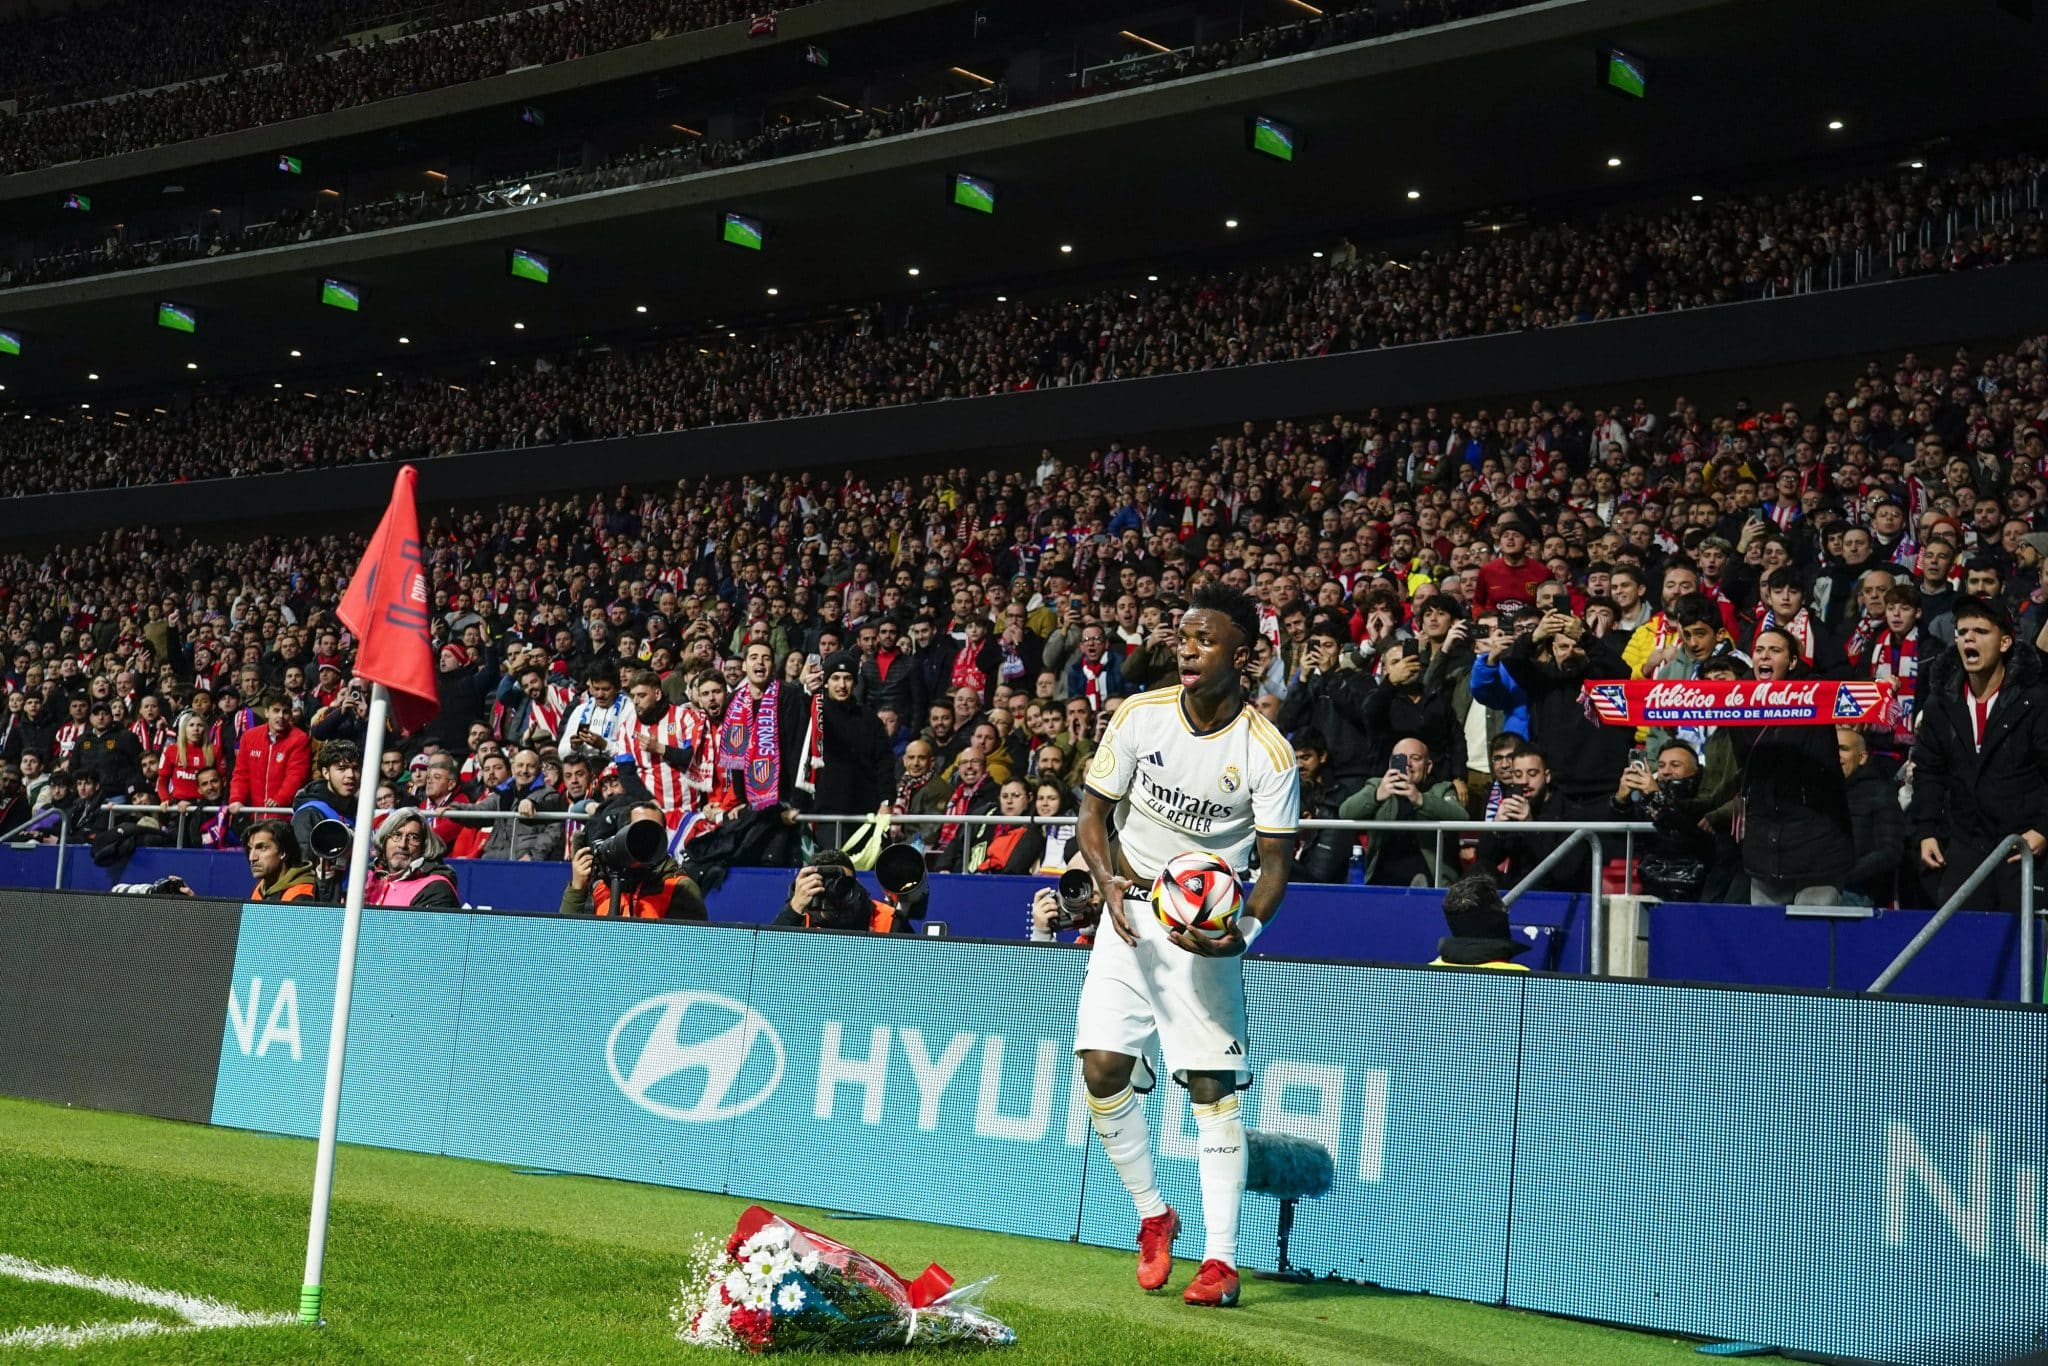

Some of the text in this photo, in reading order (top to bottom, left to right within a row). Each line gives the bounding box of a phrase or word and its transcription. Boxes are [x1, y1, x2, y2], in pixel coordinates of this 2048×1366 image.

[1644, 682, 1820, 709] Atlético de Madrid
[1648, 708, 1812, 719] CLUB ATLÉTICO DE MADRID
[1141, 770, 1234, 819] Emirates
[1166, 809, 1212, 833] BETTER
[228, 976, 303, 1062] NA
[1203, 1145, 1241, 1154] RMCF
